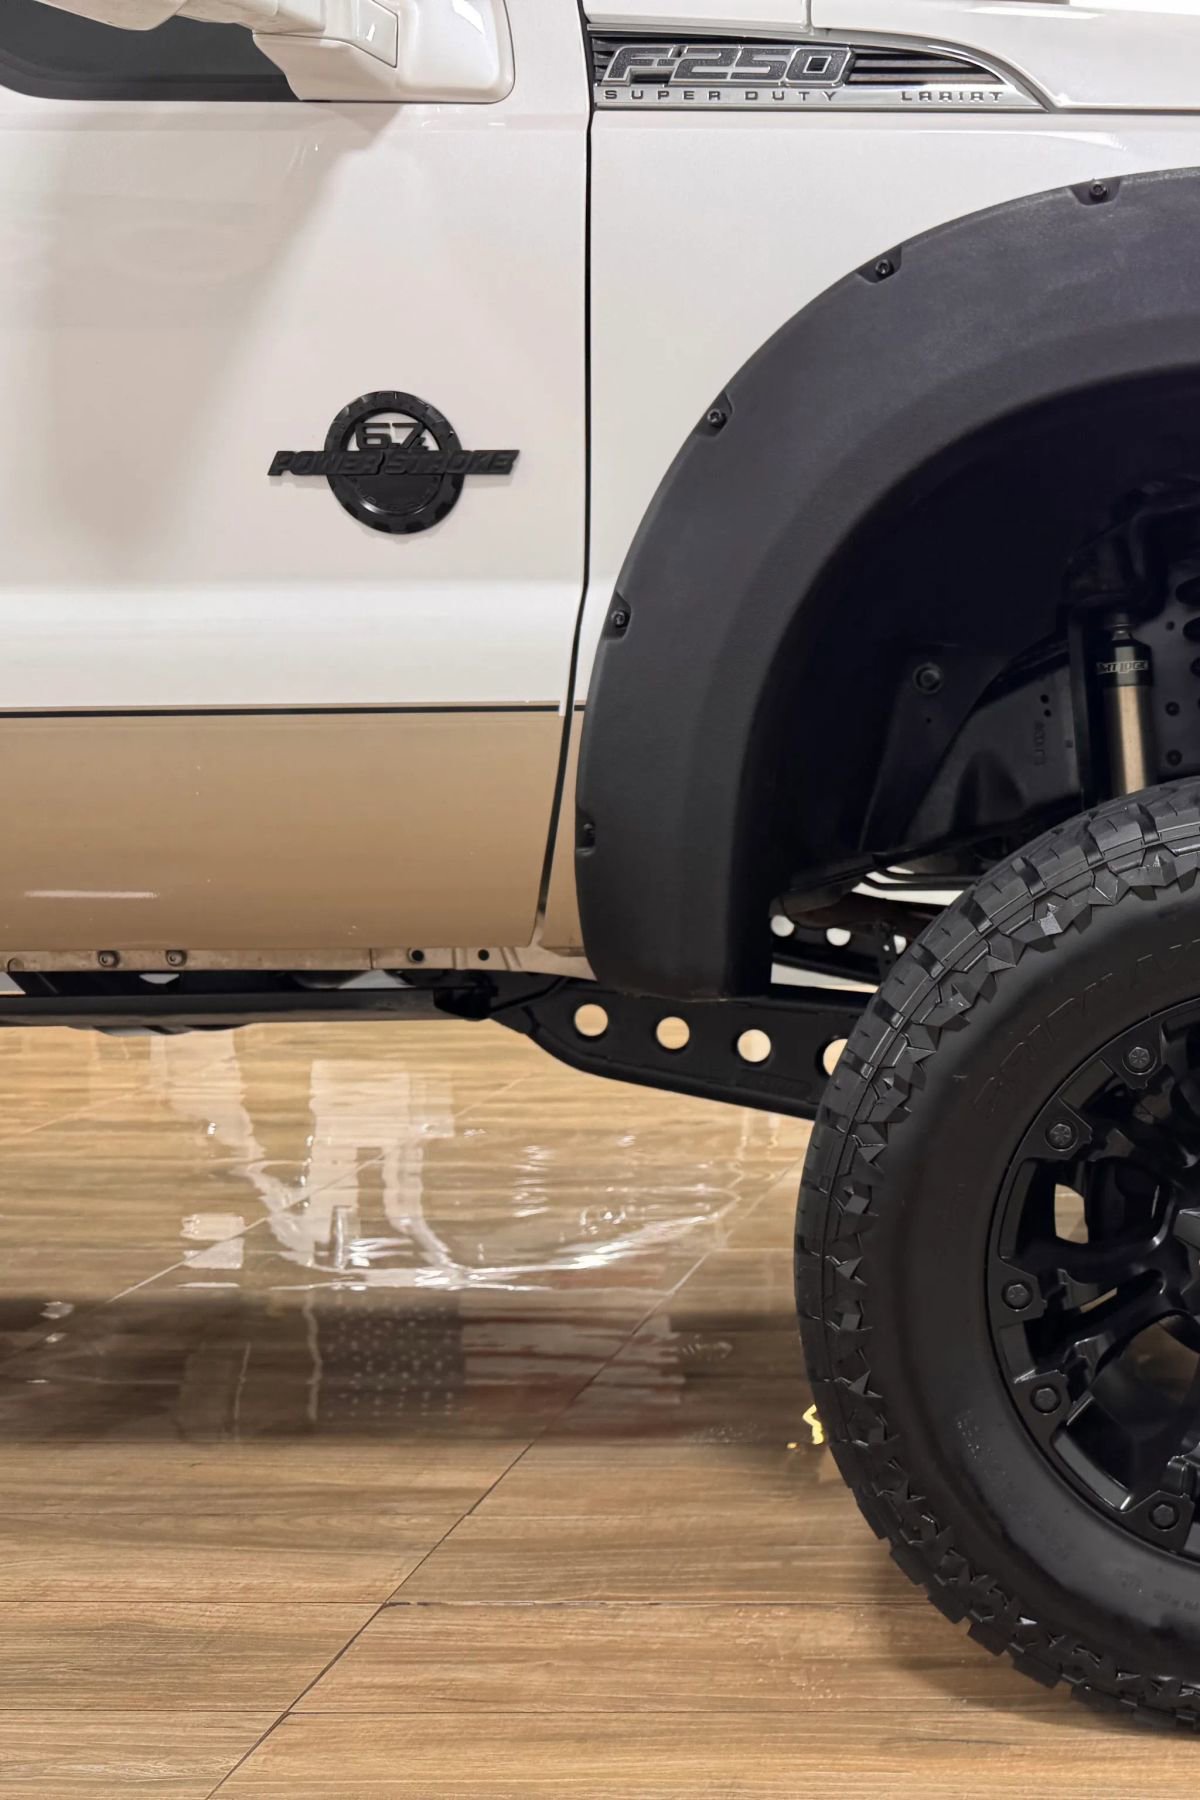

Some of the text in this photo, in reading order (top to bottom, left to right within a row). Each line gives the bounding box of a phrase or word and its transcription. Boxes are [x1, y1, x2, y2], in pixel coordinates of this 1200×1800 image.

[603, 89, 838, 102] SUPER DUTY
[900, 91, 1005, 102] LARIAT
